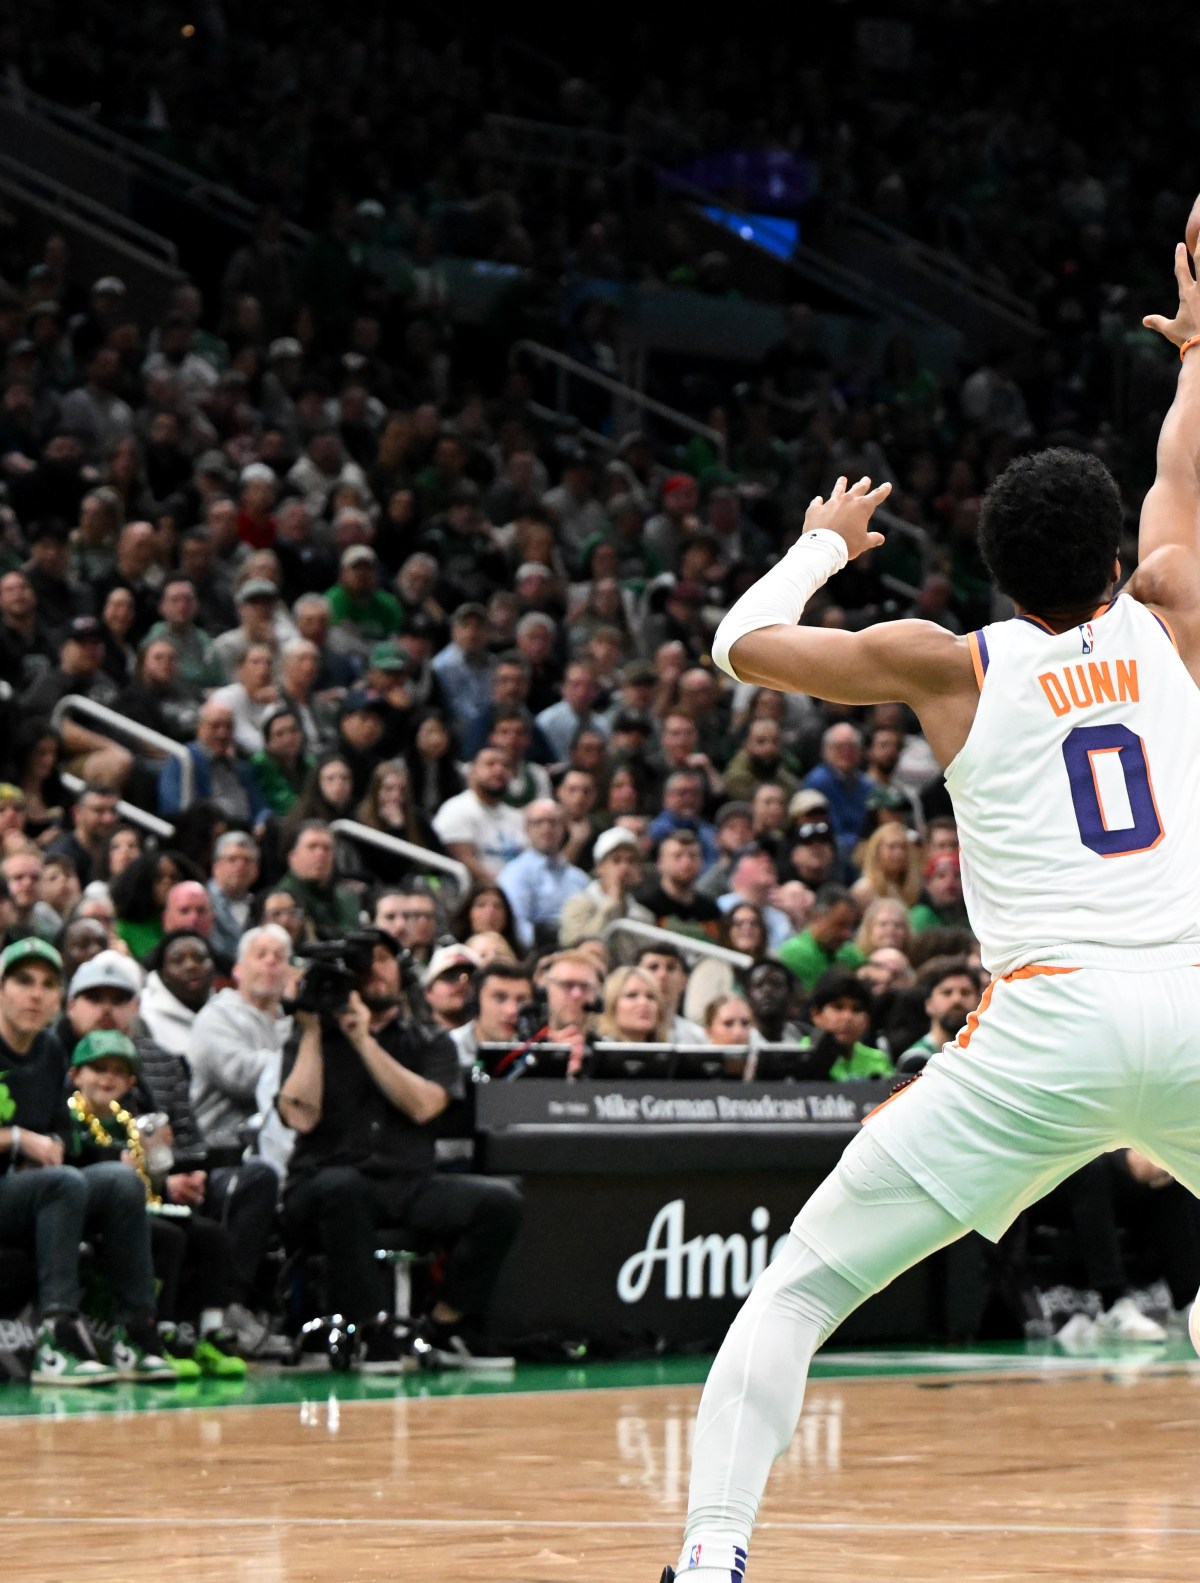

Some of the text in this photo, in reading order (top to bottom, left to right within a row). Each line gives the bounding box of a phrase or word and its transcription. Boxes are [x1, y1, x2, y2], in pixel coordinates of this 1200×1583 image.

[1038, 659, 1140, 717] DUNN
[1062, 723, 1166, 859] 0
[594, 1093, 640, 1121] Mike
[641, 1094, 717, 1121] Gorman
[717, 1094, 807, 1121] Broadcast
[807, 1094, 857, 1121] Table
